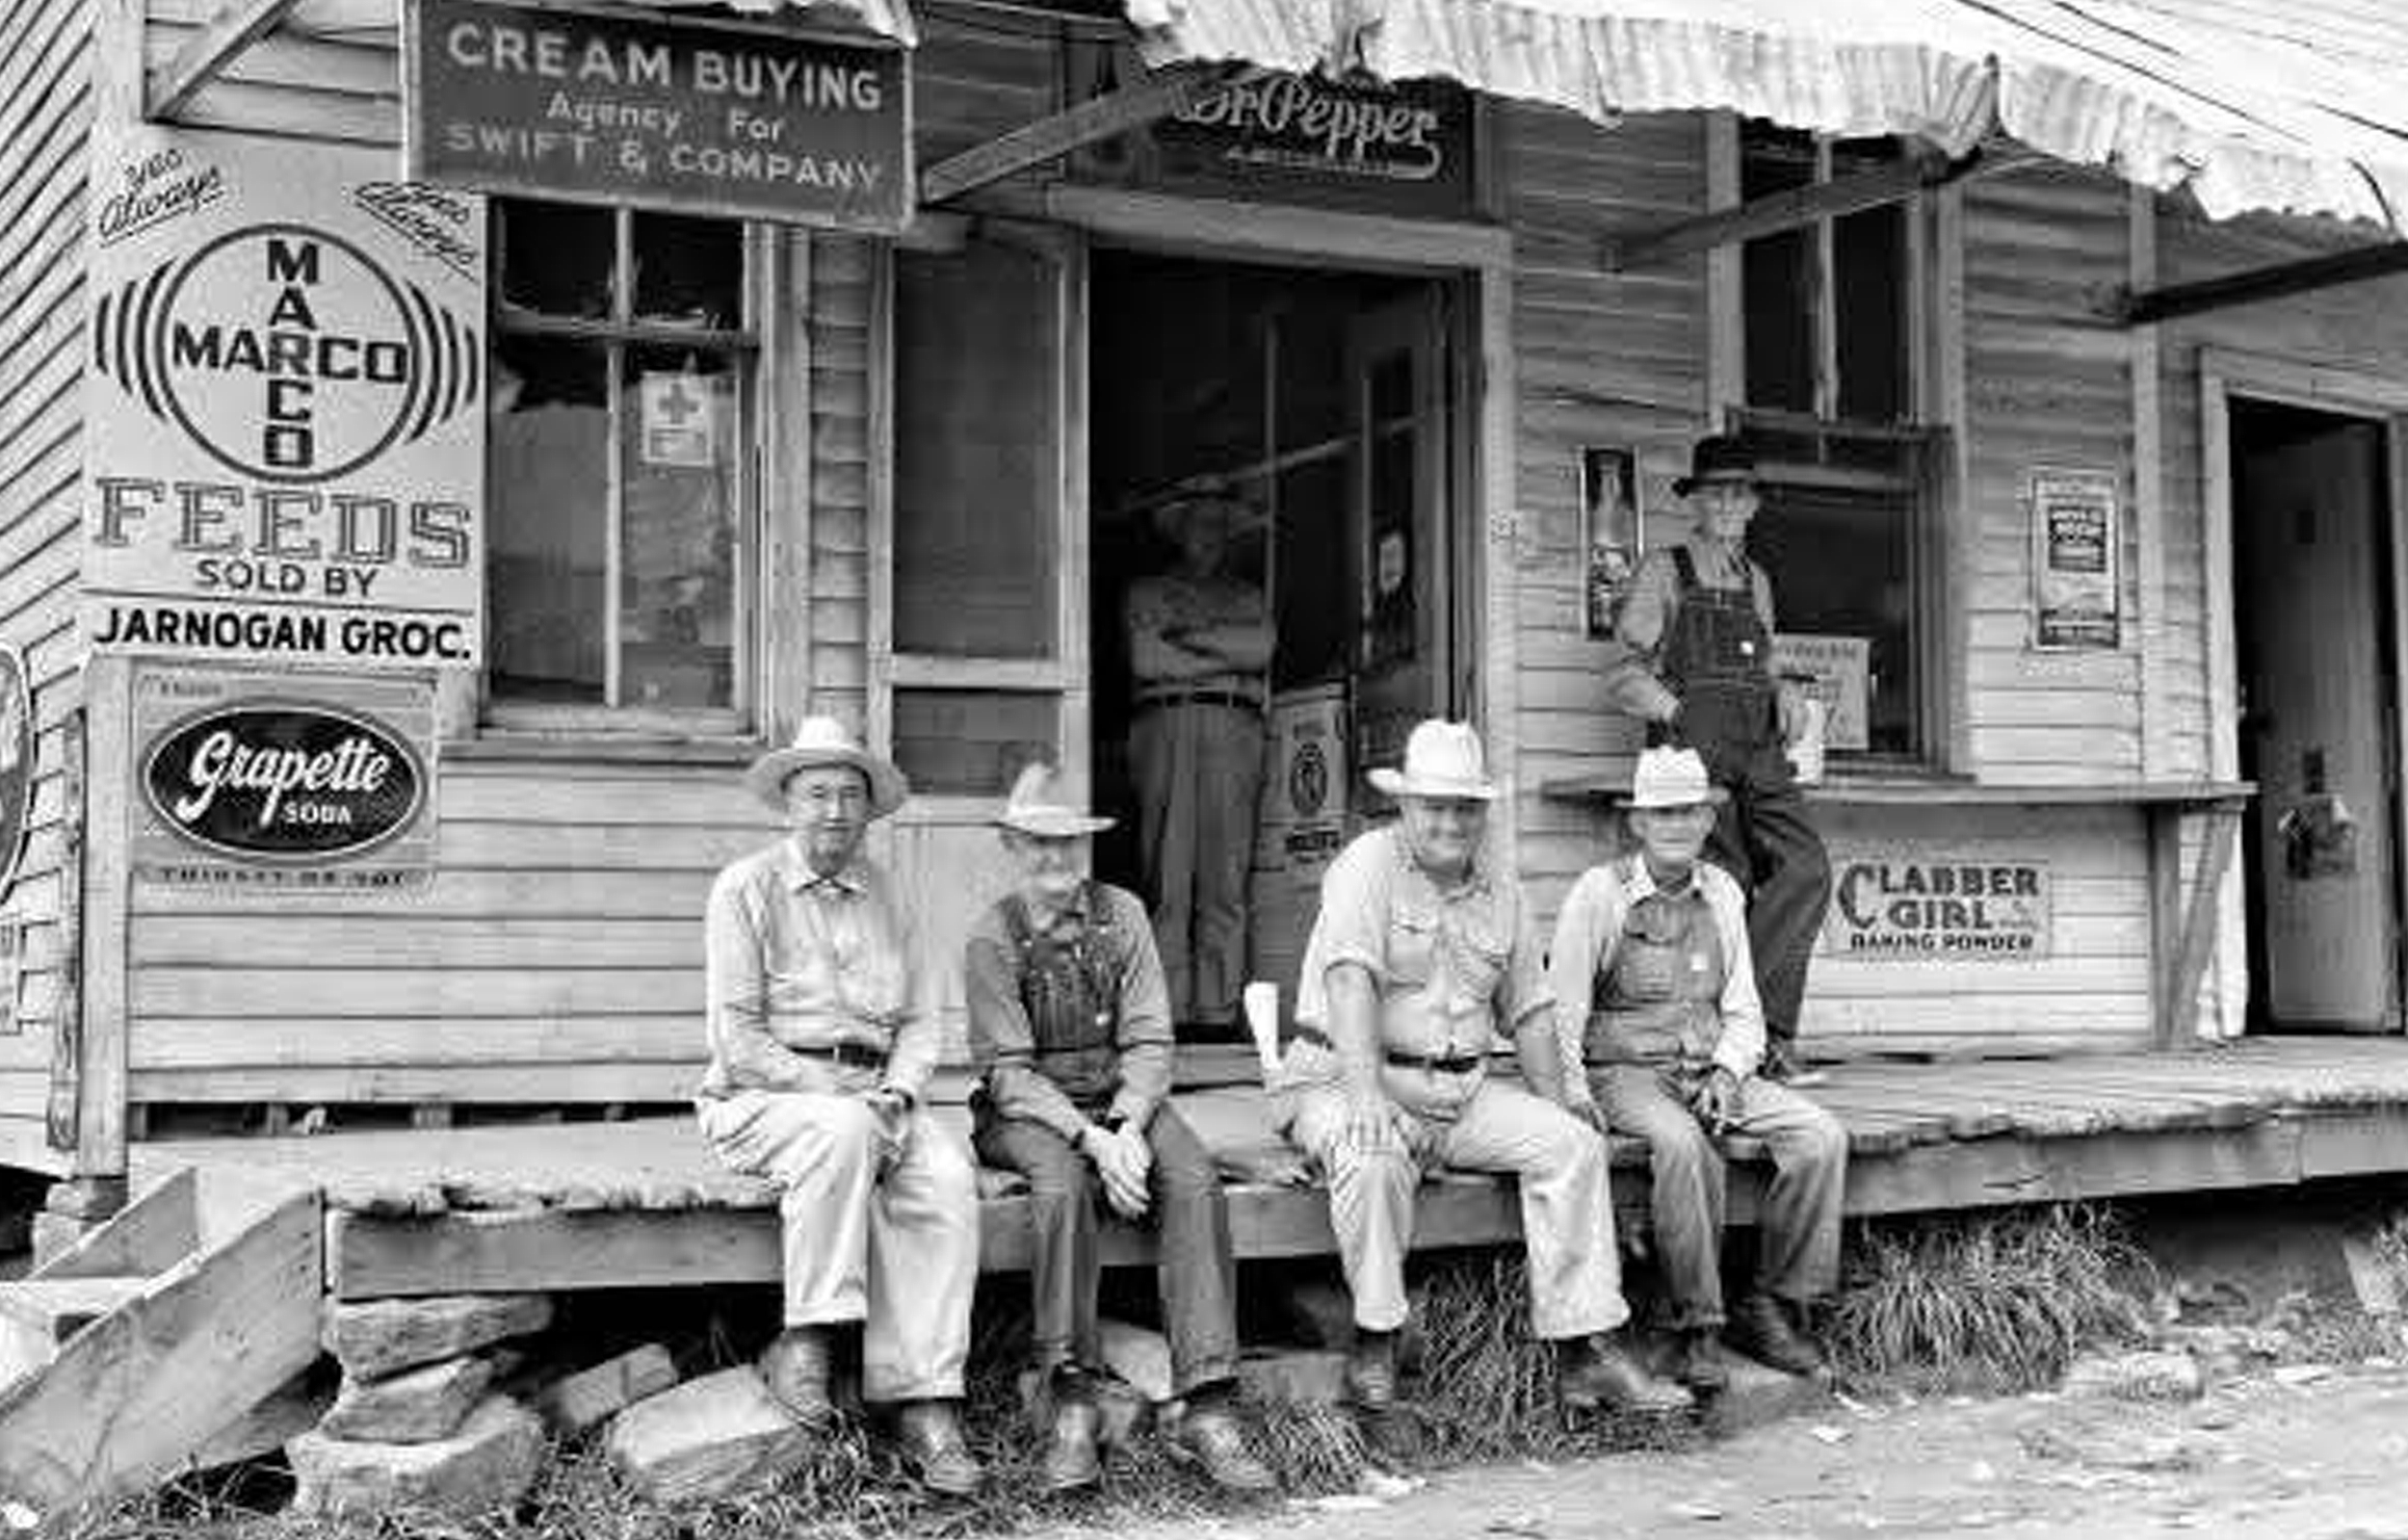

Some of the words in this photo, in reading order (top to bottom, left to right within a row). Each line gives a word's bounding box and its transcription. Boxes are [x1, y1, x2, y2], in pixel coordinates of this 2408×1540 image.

[447, 22, 671, 86] CREAM
[694, 50, 882, 110] BUYING
[546, 91, 682, 137] Agency
[727, 108, 786, 142] For
[446, 122, 595, 165] SWIFT
[619, 140, 648, 175] &
[670, 143, 882, 187] COMPANY
[173, 322, 408, 384] MARCO
[265, 239, 319, 468] MARCO
[93, 477, 471, 568] FEEDS
[196, 558, 306, 594] SOLD
[324, 566, 379, 597] BY
[94, 608, 327, 653] JARNOGAN
[340, 618, 472, 660] GROC.
[174, 730, 390, 828] Grapette
[284, 801, 353, 825] SODA
[1837, 864, 2040, 930] CLABBER
[1888, 900, 1993, 930] GIRL
[1851, 932, 1935, 953] BAKING
[1942, 932, 2033, 953] POWDER
